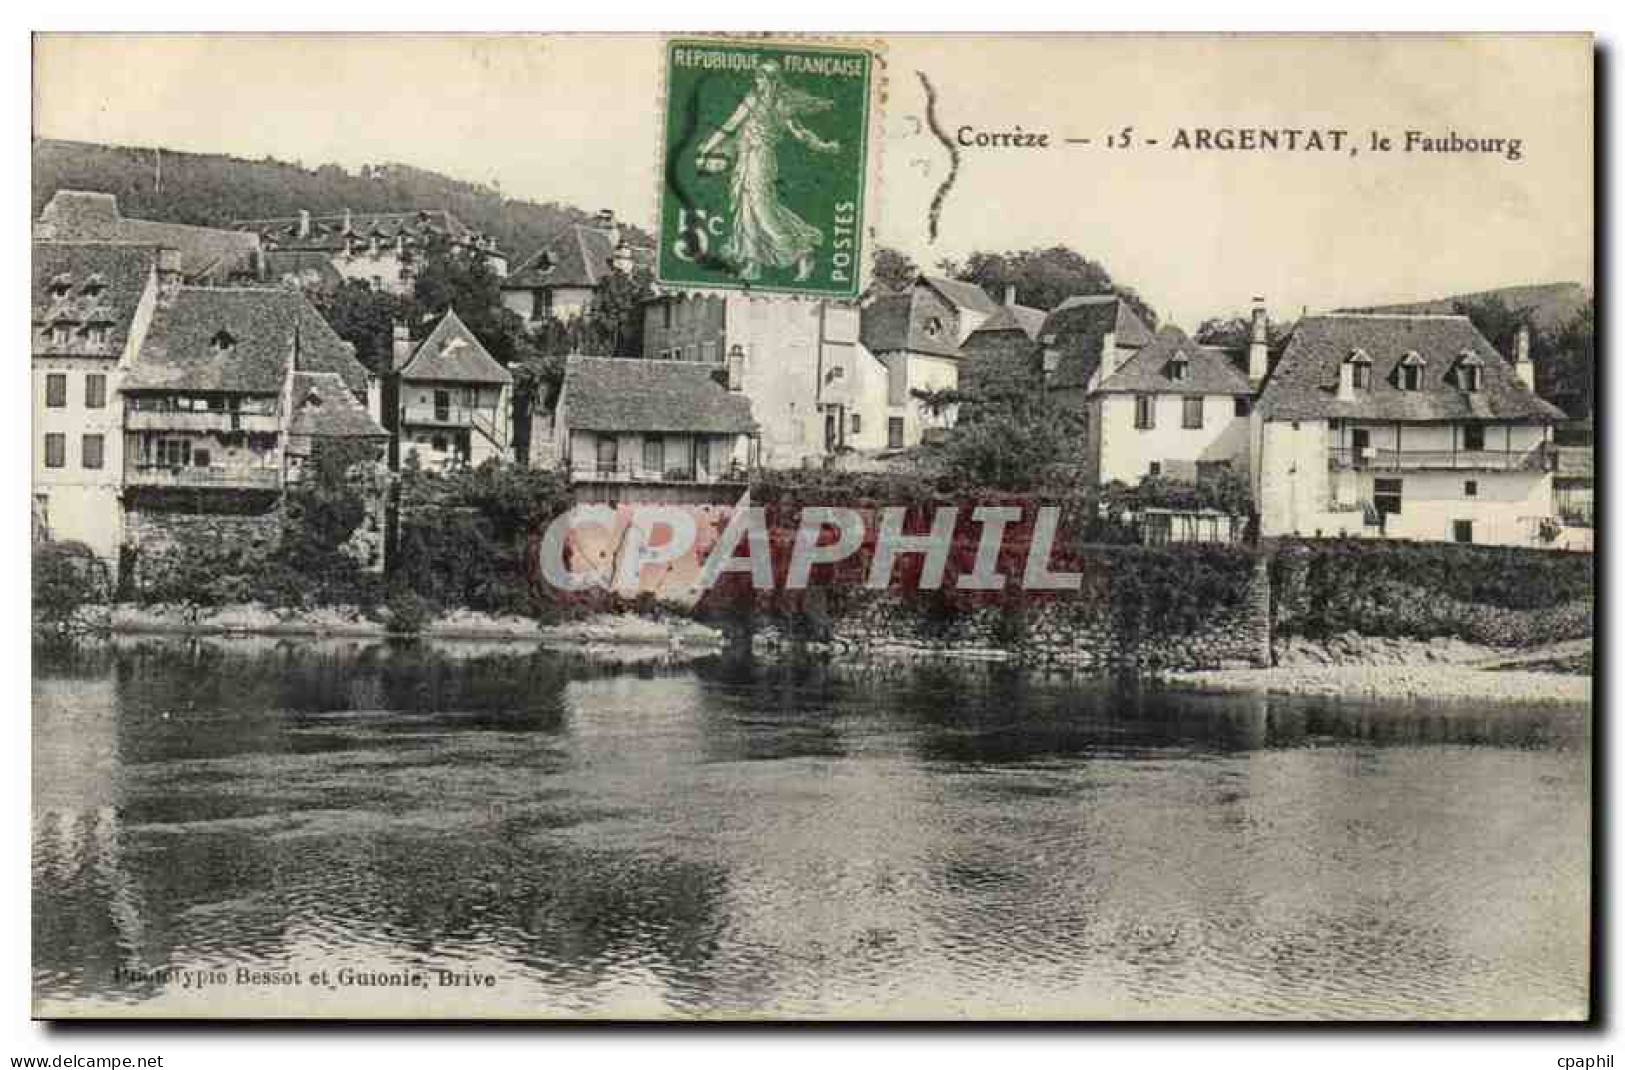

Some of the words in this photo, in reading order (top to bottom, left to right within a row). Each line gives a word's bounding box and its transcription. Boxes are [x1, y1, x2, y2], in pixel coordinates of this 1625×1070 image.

[957, 125, 1049, 148] Corrèze
[1107, 127, 1133, 149] 15
[1172, 128, 1358, 156] ARGENTAT,
[1370, 131, 1391, 151] le
[1405, 130, 1522, 160] Faubourg
[832, 201, 855, 281] POSTES
[236, 967, 302, 986] Bessot
[309, 970, 330, 986] et
[439, 969, 496, 987] Brive
